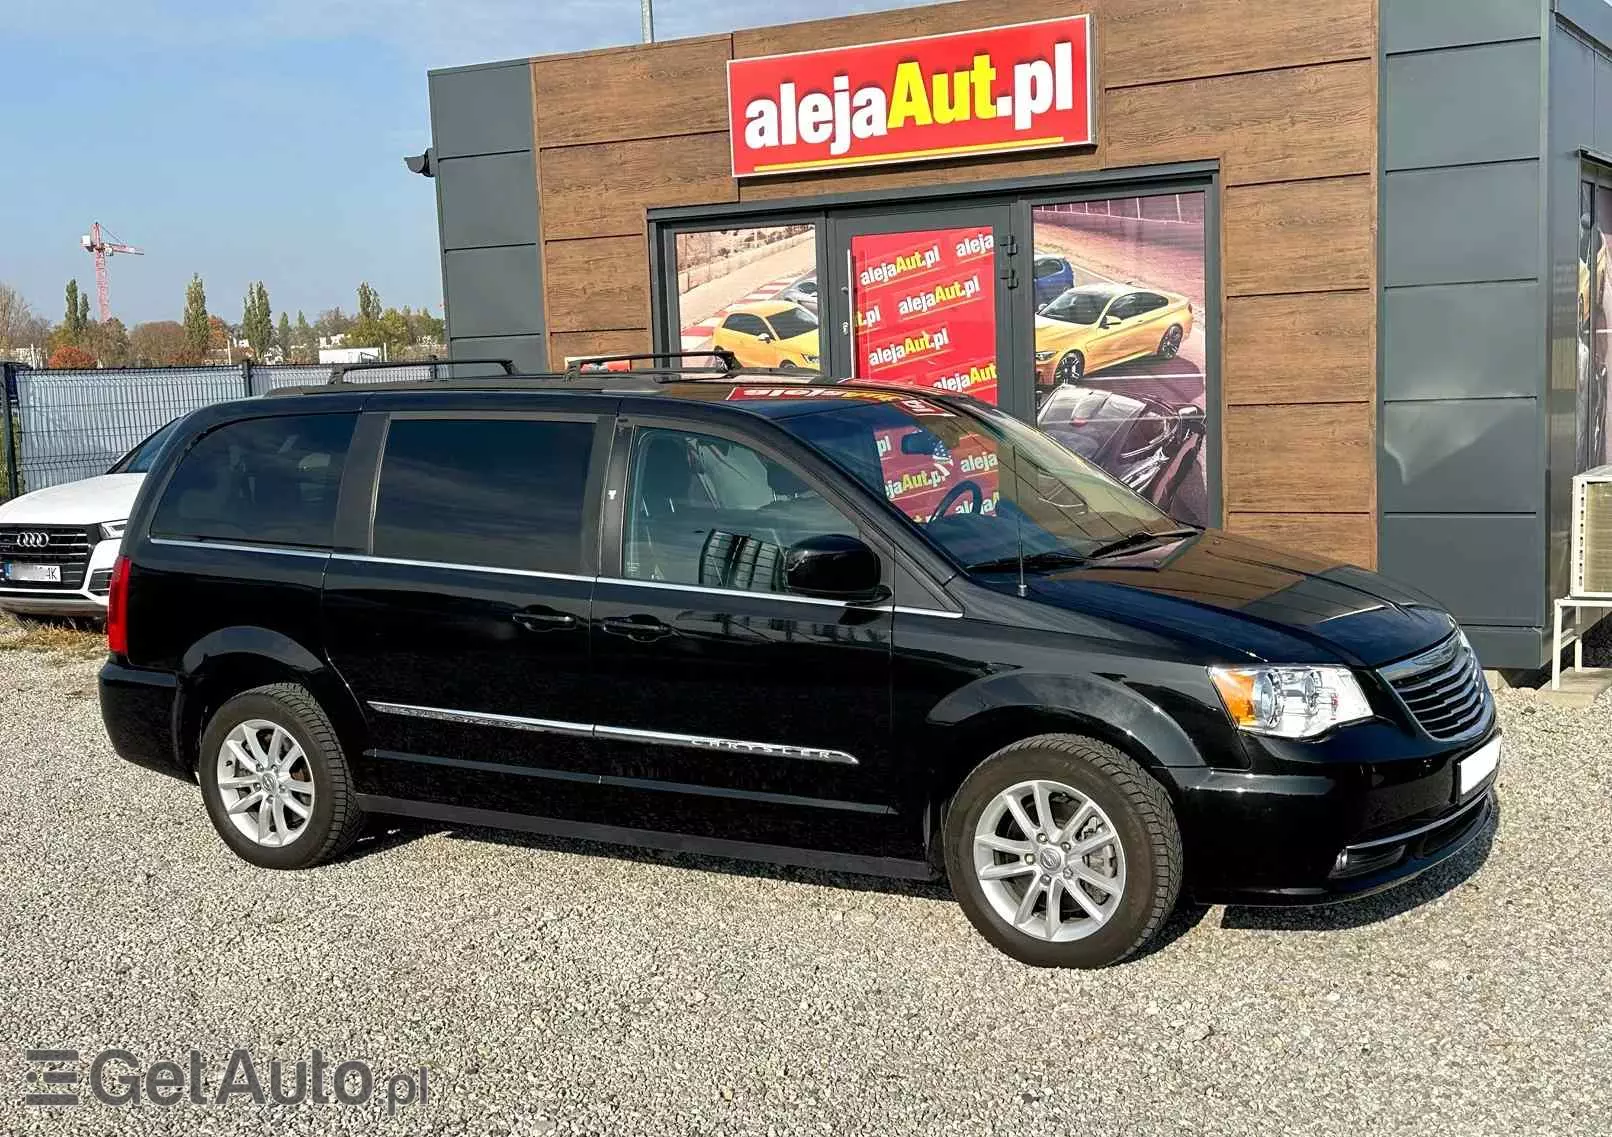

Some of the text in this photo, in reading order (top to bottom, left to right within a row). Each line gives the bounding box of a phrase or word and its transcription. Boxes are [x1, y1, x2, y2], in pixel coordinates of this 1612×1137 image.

[744, 41, 1073, 155] alejaAut.pl
[956, 234, 993, 256] aleja
[860, 245, 940, 285] alejaAut.pl
[898, 275, 980, 314] alejaAut.pl
[868, 327, 949, 366] alejaAut.pl
